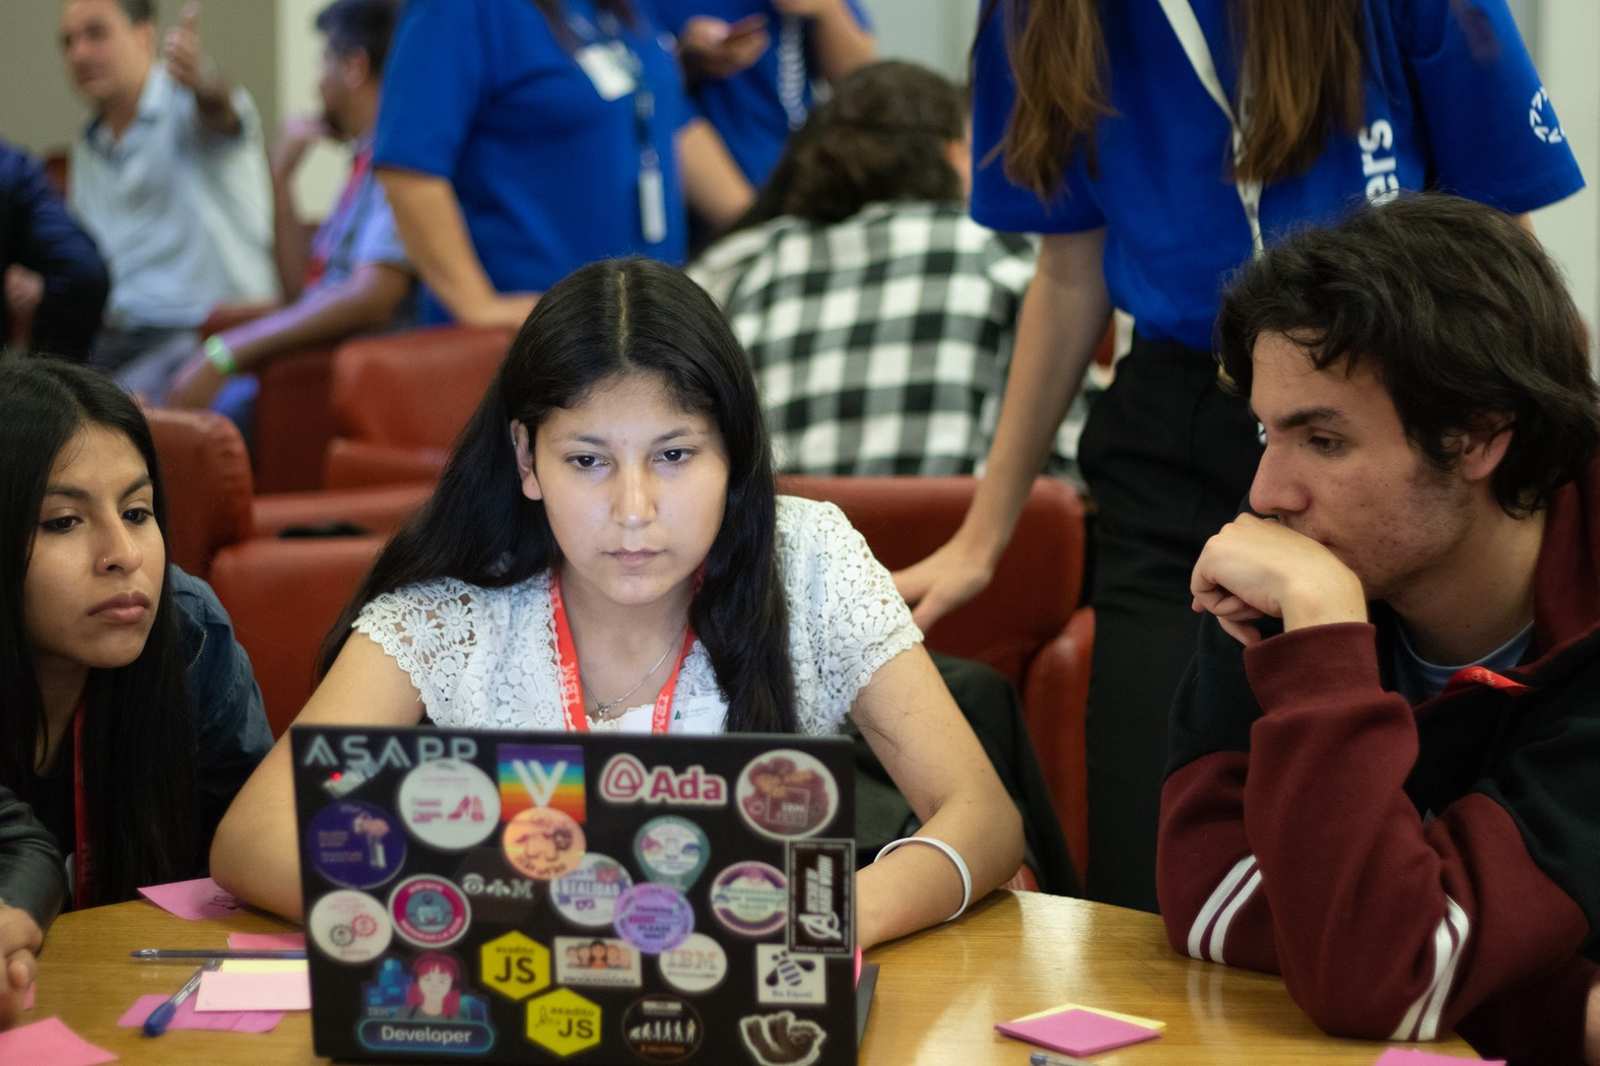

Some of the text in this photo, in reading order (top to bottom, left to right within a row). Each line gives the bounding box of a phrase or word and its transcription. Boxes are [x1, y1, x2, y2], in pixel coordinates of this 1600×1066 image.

[304, 735, 477, 766] ASAPP
[650, 767, 724, 801] Ada
[494, 955, 537, 985] JS
[380, 1025, 473, 1046] Developer
[557, 1017, 594, 1040] JS
